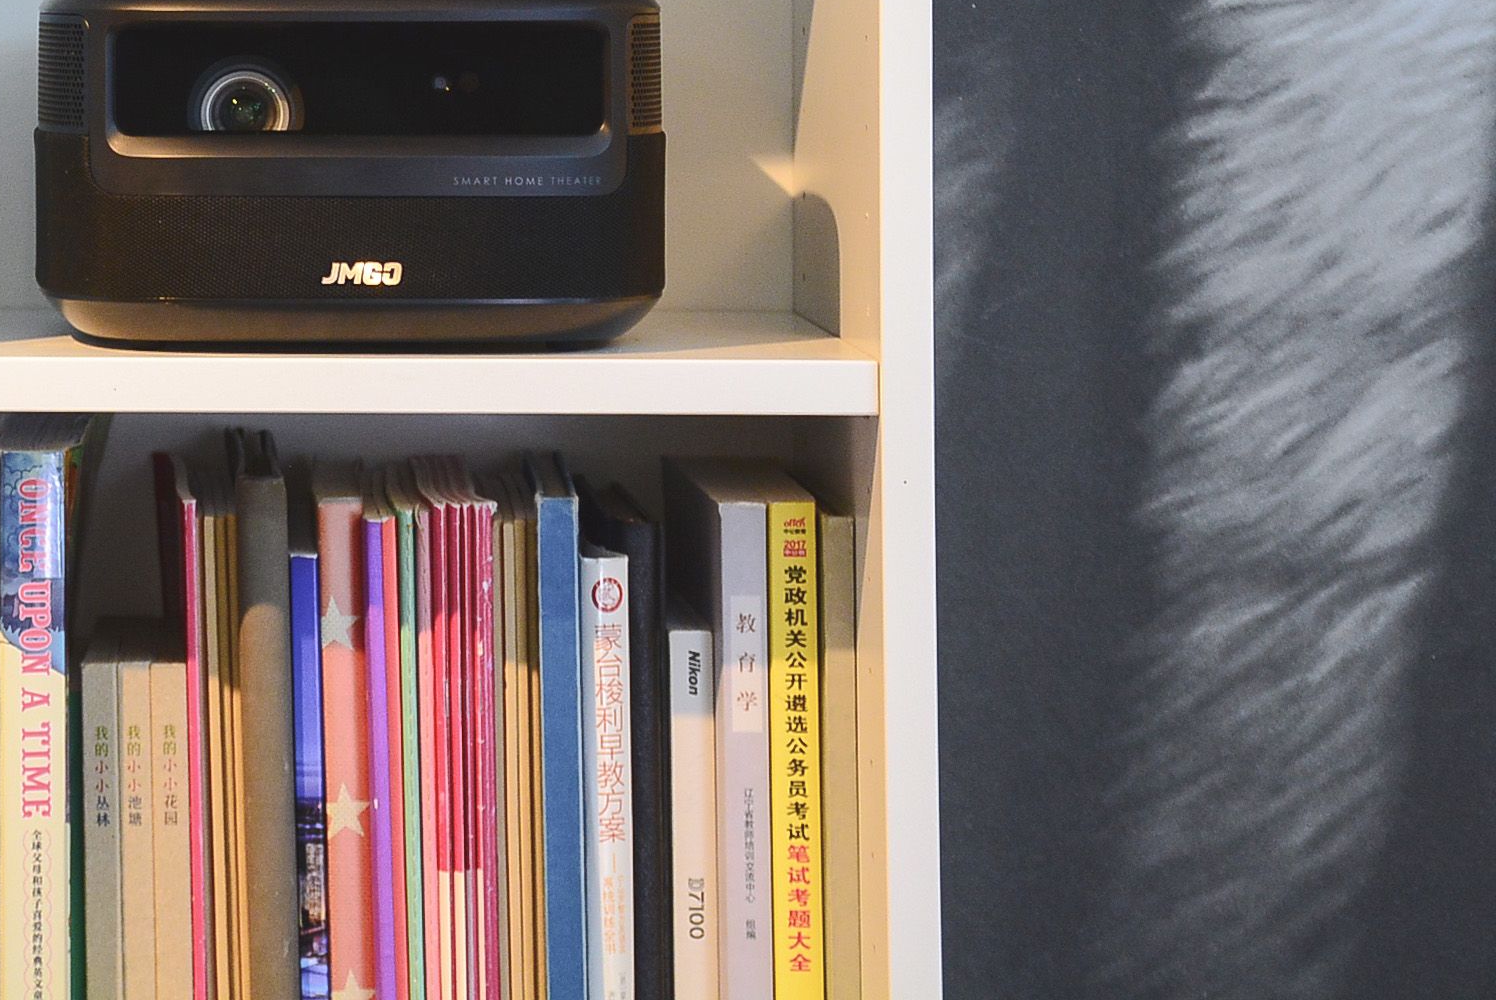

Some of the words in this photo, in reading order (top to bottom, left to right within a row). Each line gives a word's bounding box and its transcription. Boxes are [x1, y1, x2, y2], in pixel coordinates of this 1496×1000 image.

[453, 176, 497, 186] SMART
[505, 176, 544, 186] HOME
[550, 175, 603, 186] THEATER
[783, 540, 807, 550] 2017
[18, 579, 52, 676] UPON
[688, 650, 701, 696] Nikon
[736, 613, 758, 713] 教育学
[21, 687, 51, 712] A
[594, 623, 626, 844] 蒙台梭利早教方案
[21, 721, 52, 819] TIME
[94, 726, 111, 827] 我的小小丛林
[127, 725, 143, 827] 我的小小池塘
[162, 724, 178, 826] 我的小小花园
[688, 878, 705, 940] D7100
